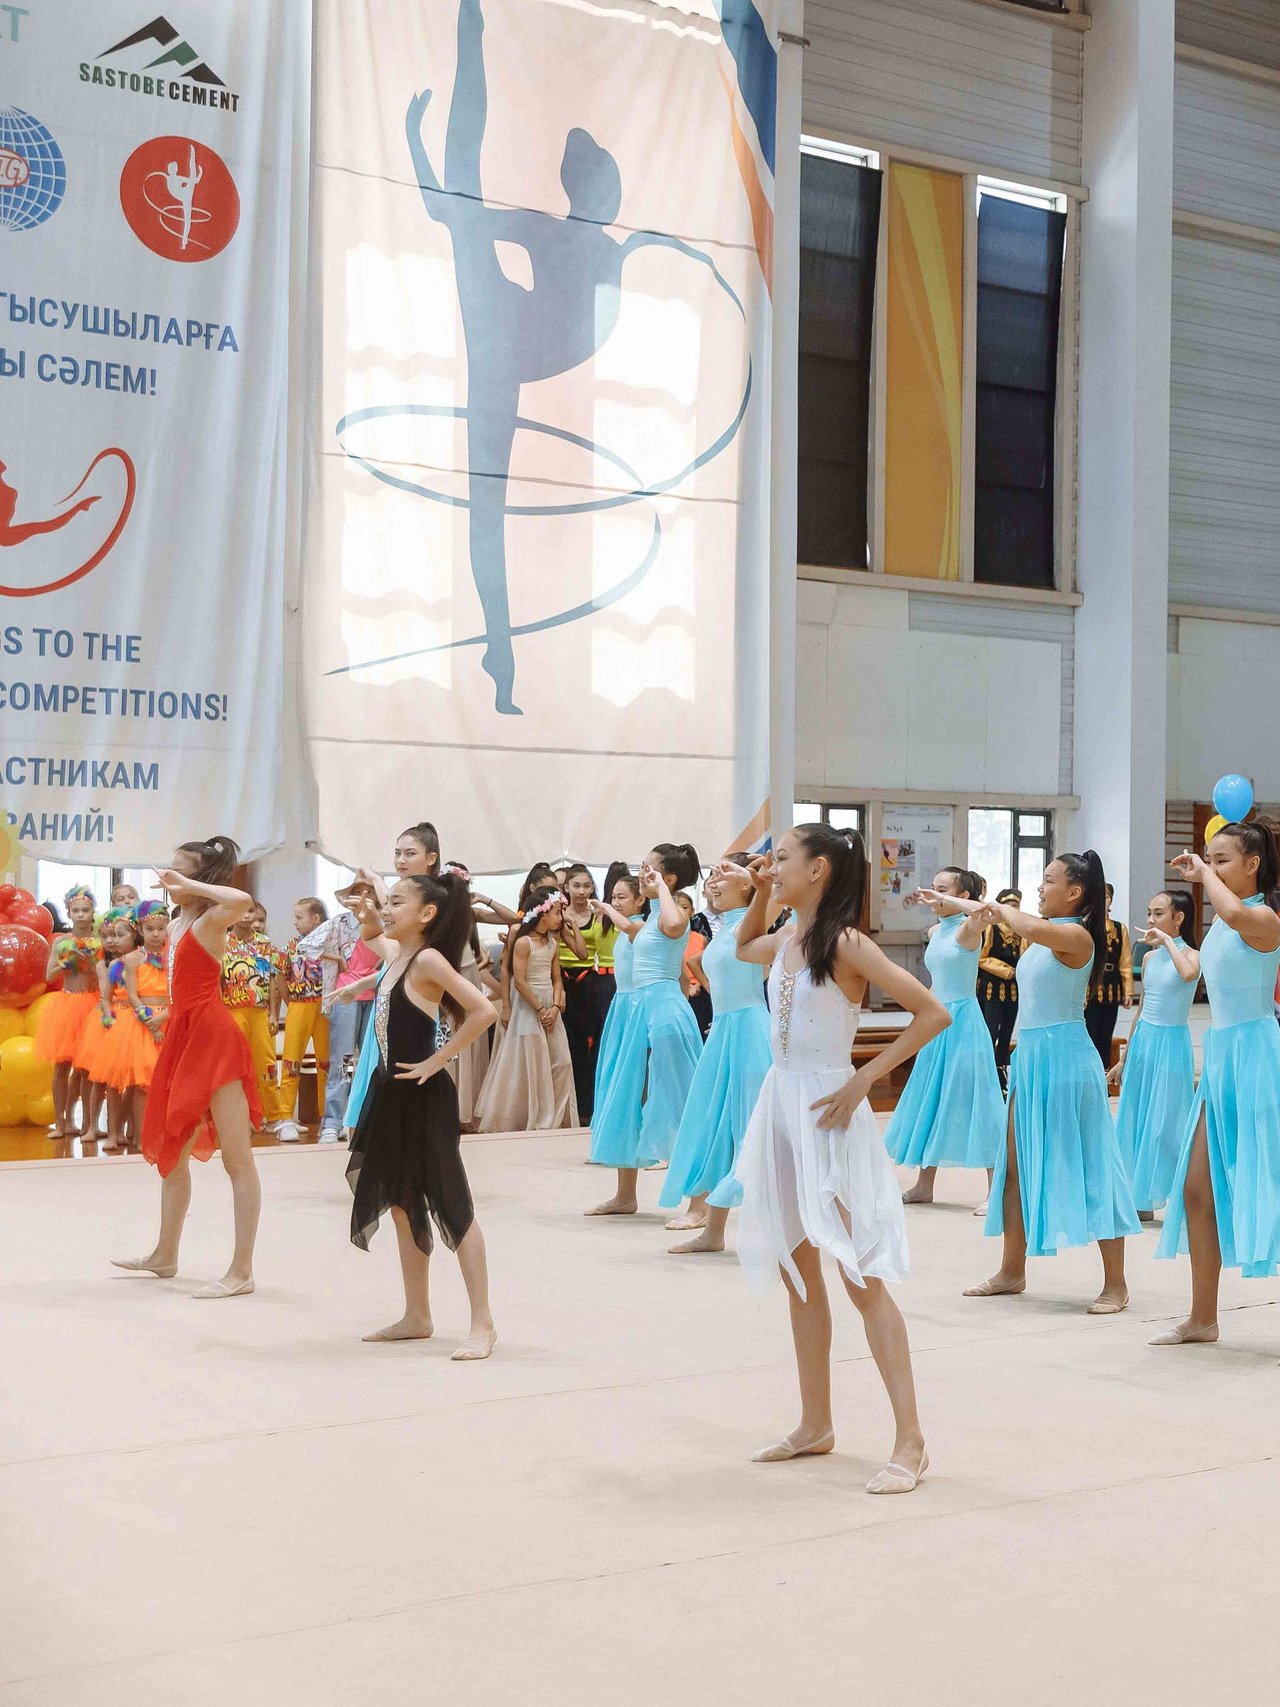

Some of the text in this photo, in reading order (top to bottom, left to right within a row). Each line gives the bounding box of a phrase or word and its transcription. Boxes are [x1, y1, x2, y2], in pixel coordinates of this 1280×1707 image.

[79, 62, 239, 112] SASTOBE CEMENT
[37, 353, 157, 396] СӘЛЕМ!
[0, 626, 142, 663] S TO THE
[0, 756, 160, 790] СТНИКАМ
